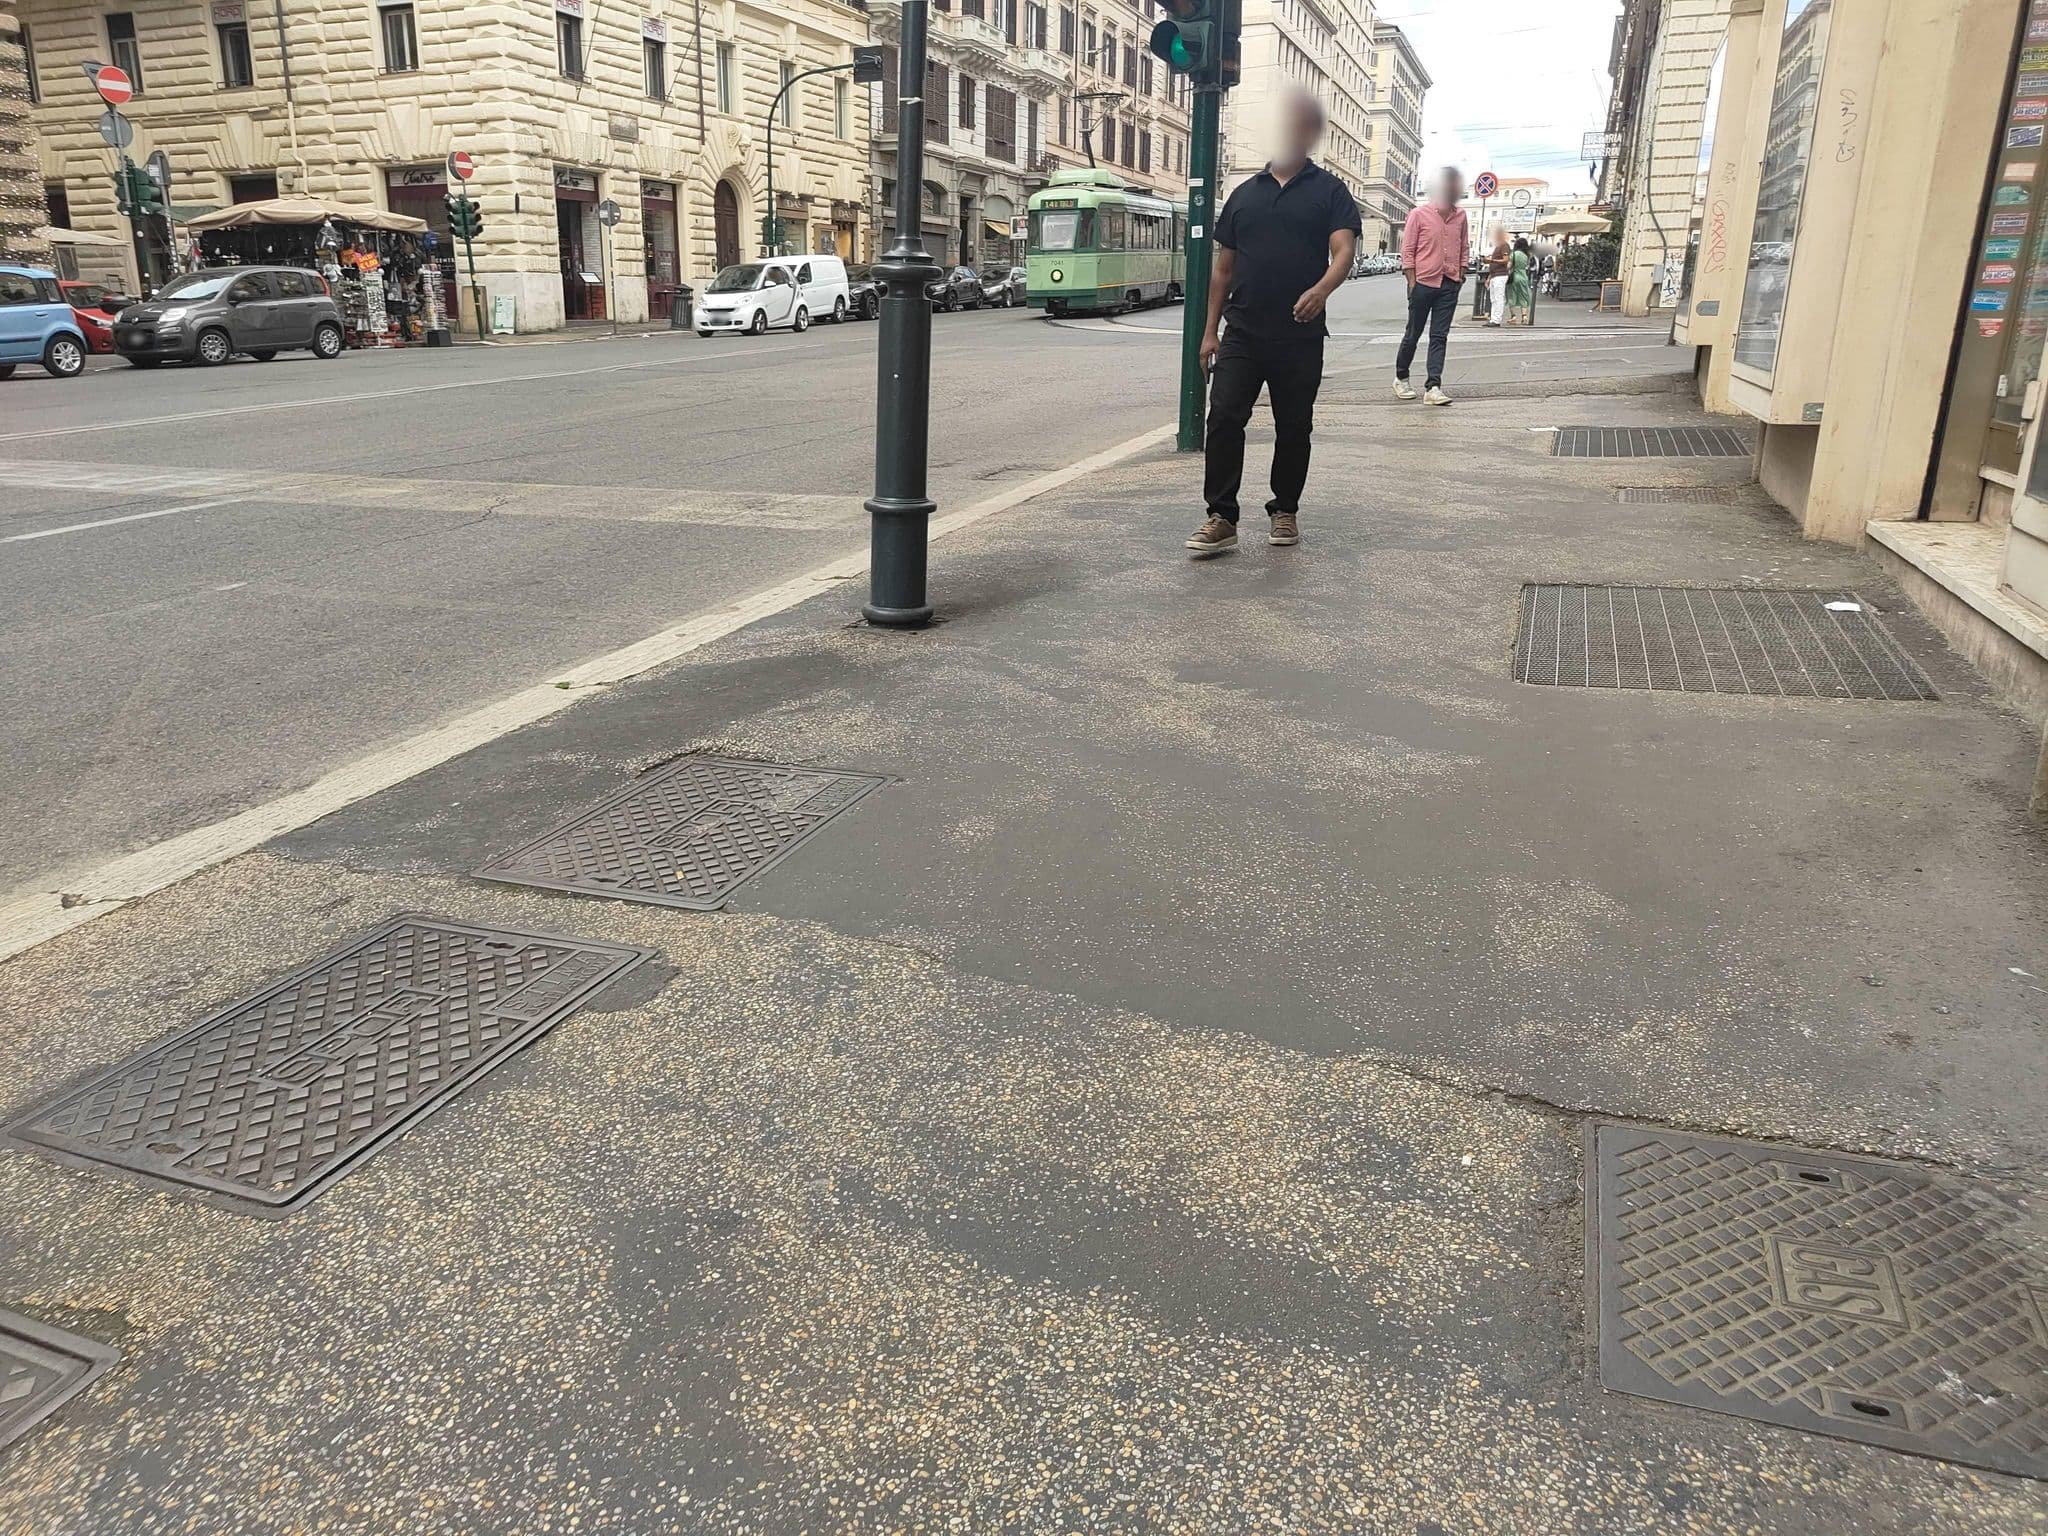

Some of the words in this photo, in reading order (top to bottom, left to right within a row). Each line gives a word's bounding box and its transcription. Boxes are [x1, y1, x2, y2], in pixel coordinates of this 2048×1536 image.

[504, 955, 598, 1010] STIMA
[272, 994, 435, 1082] SPQR
[1791, 1246, 1885, 1316] GAS
